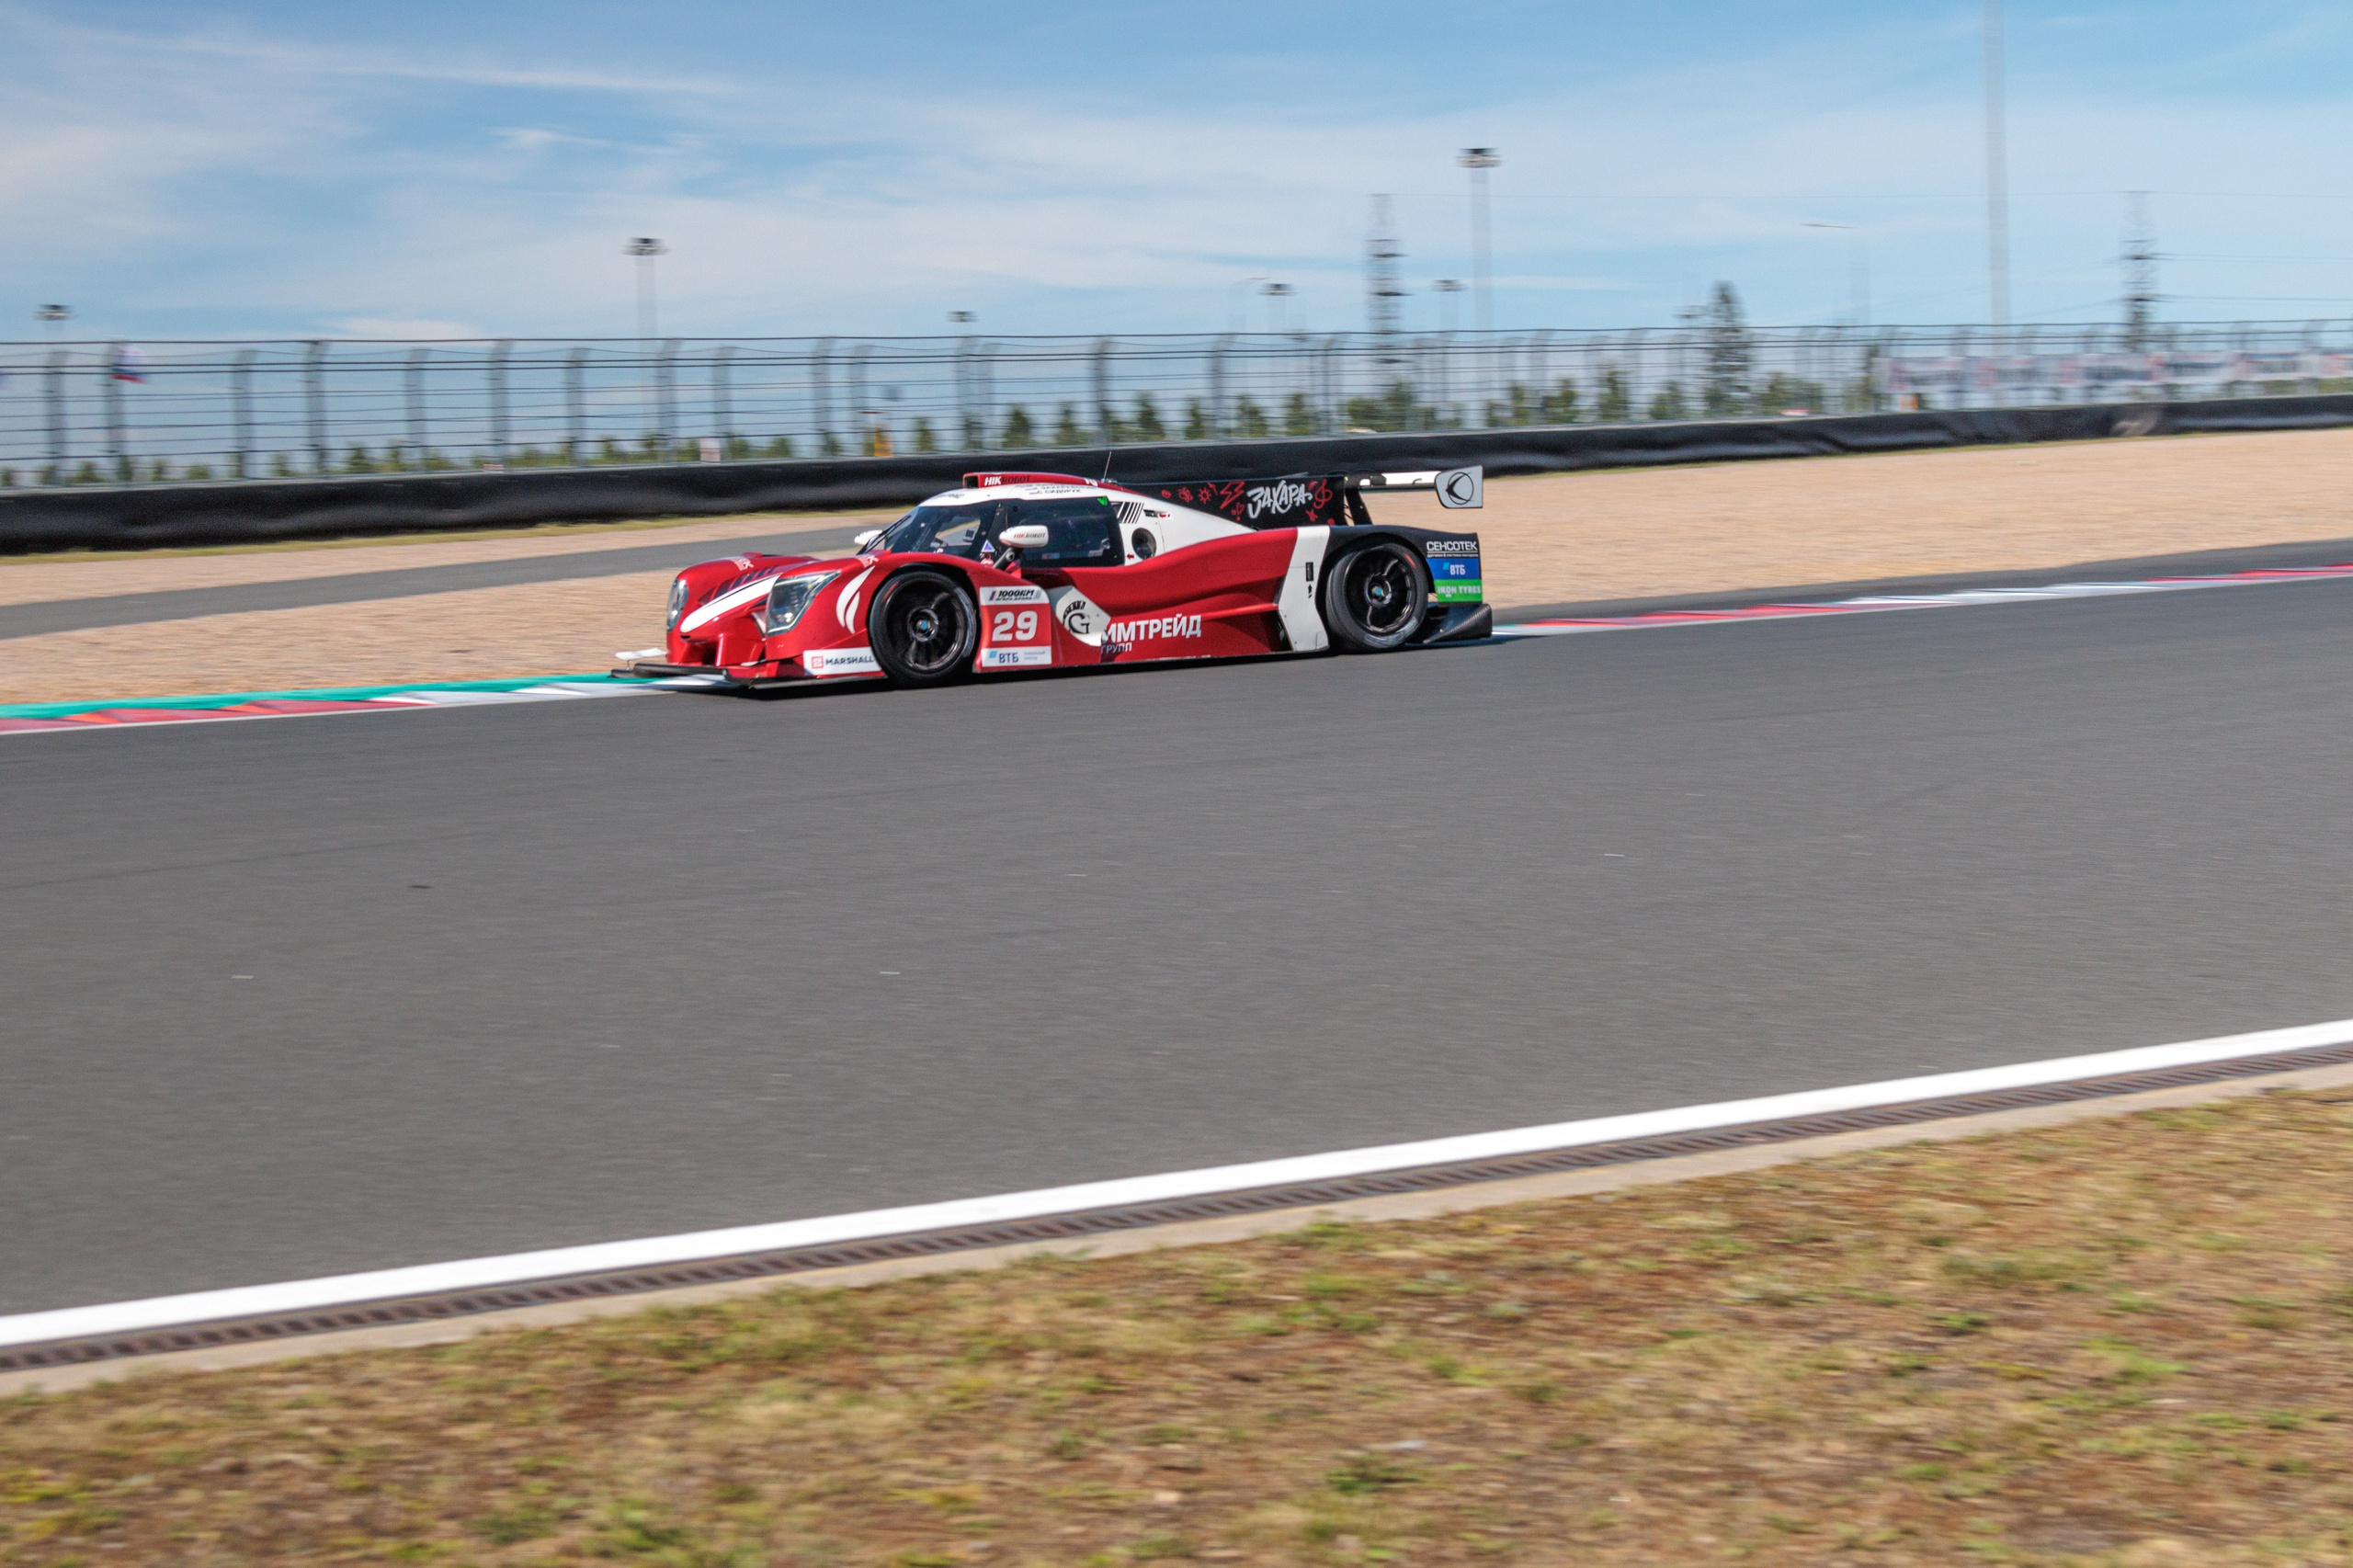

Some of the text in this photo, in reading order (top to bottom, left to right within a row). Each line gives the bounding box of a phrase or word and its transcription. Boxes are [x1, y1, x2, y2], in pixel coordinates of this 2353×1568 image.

[1427, 540, 1478, 551] СЕНСОТЕК
[1449, 563, 1466, 575] ВТБ
[1438, 585, 1481, 594] IKON TYRES
[992, 610, 1038, 642] 29
[825, 655, 874, 665] MARSHALL
[998, 652, 1019, 664] ВТБ
